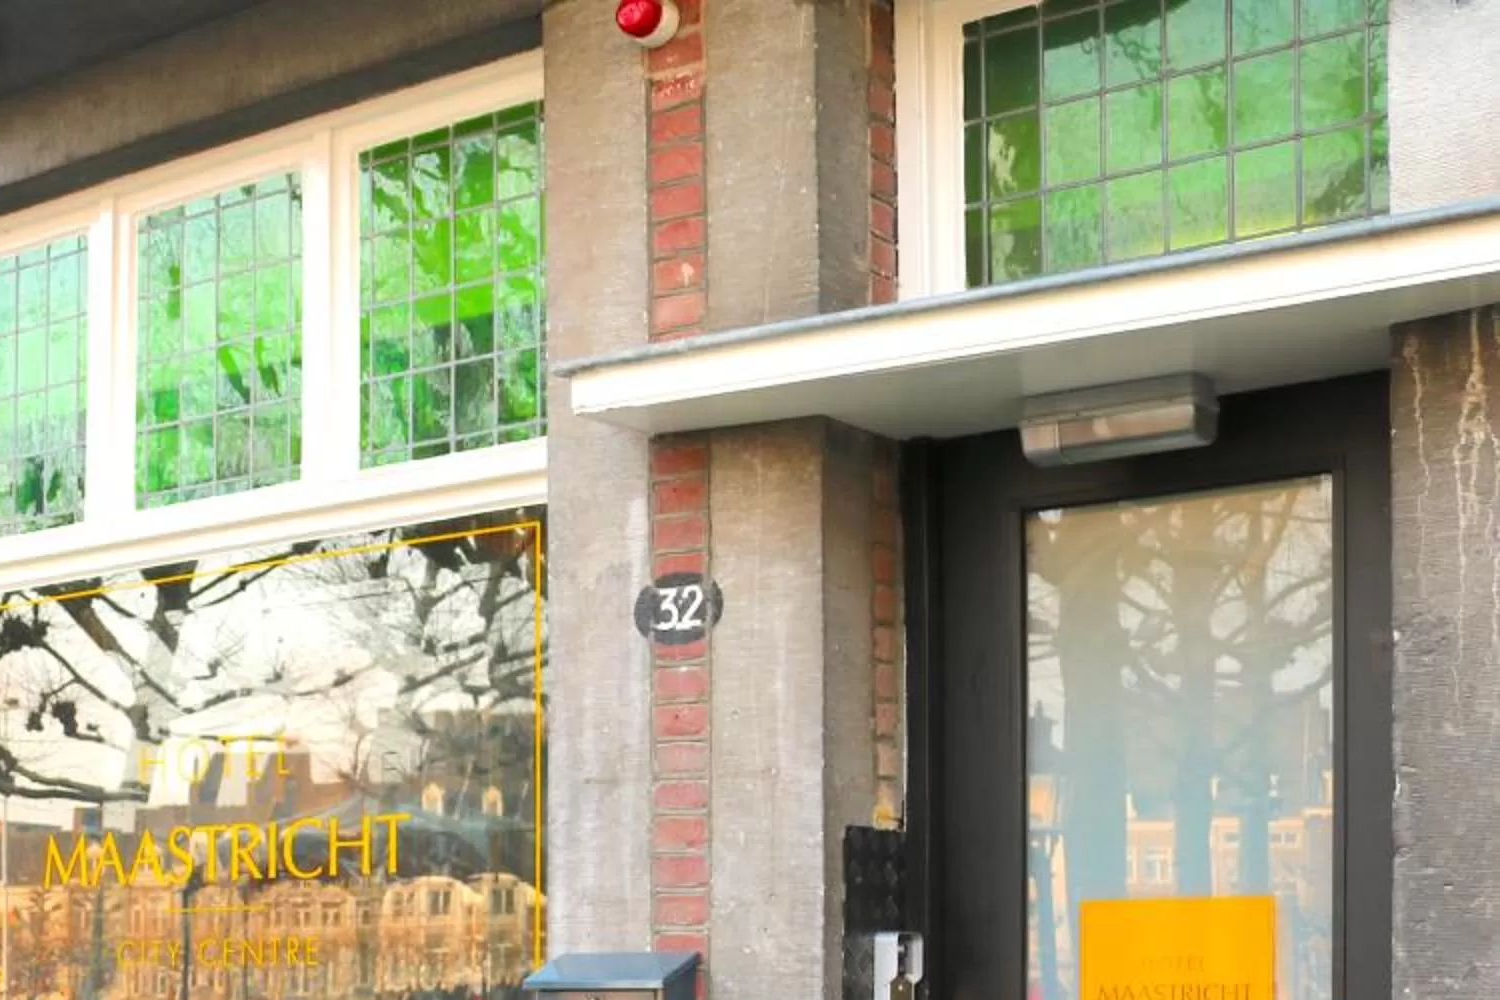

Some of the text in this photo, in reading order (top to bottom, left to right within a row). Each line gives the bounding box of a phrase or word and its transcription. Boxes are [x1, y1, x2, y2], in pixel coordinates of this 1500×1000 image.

[653, 584, 704, 631] 32
[138, 732, 291, 785] HOTEL
[43, 813, 411, 889] MAASTRICHT
[116, 935, 321, 968] CITY CENTRE
